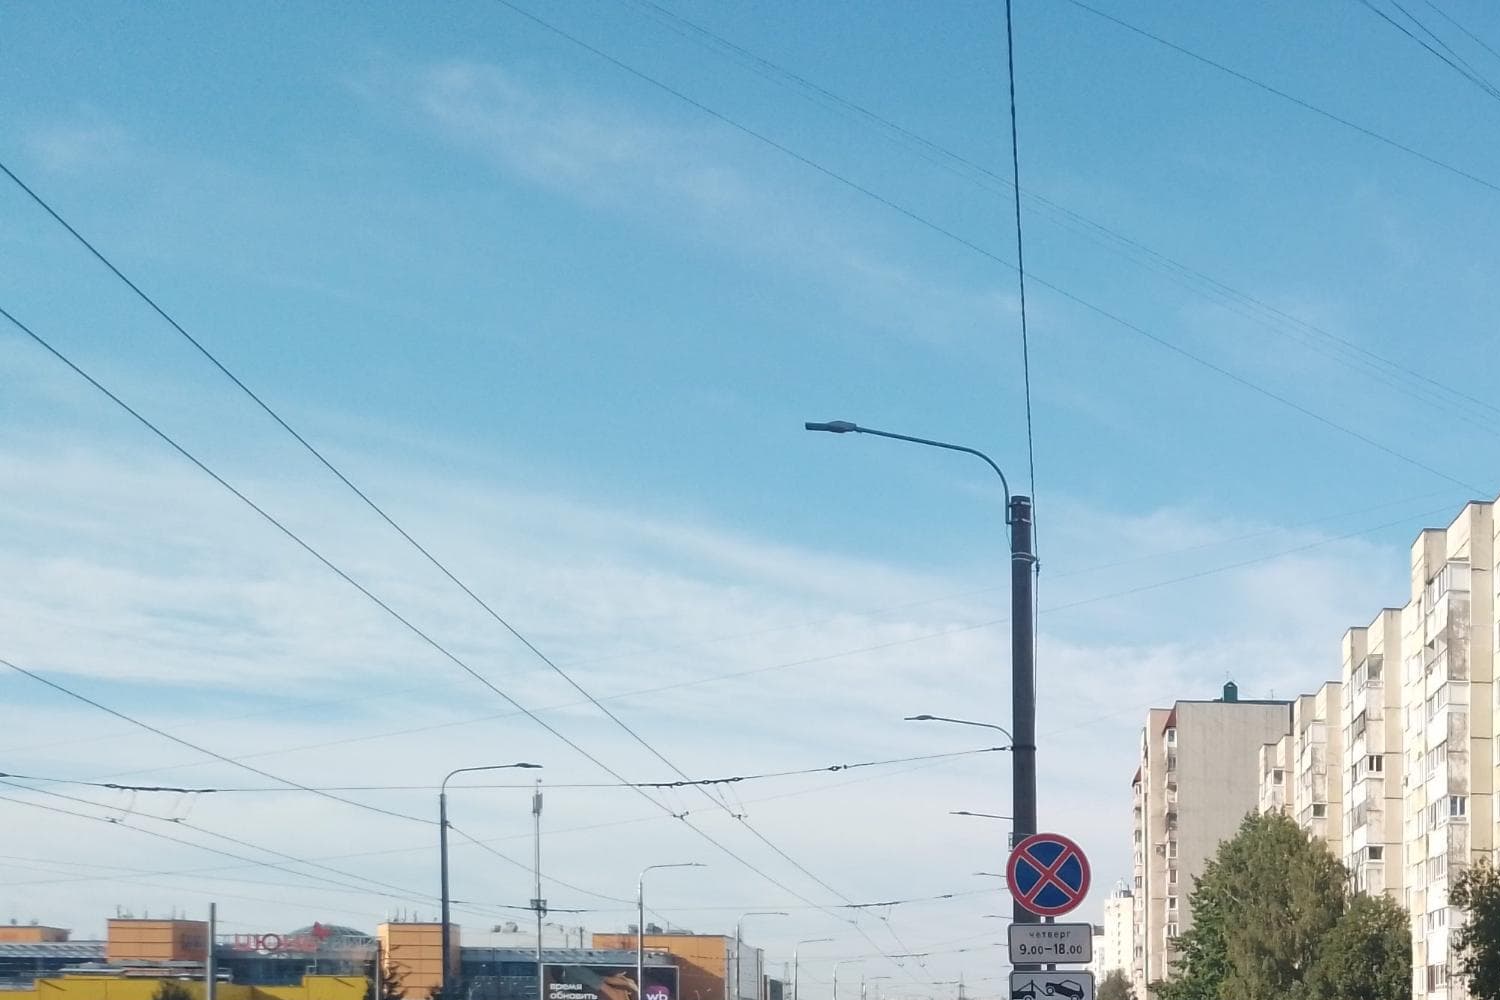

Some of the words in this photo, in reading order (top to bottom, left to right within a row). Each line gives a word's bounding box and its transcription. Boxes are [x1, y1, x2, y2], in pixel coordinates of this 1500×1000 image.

[1029, 930, 1071, 939] четверг
[549, 983, 583, 992] время
[549, 991, 598, 1000] обновить
